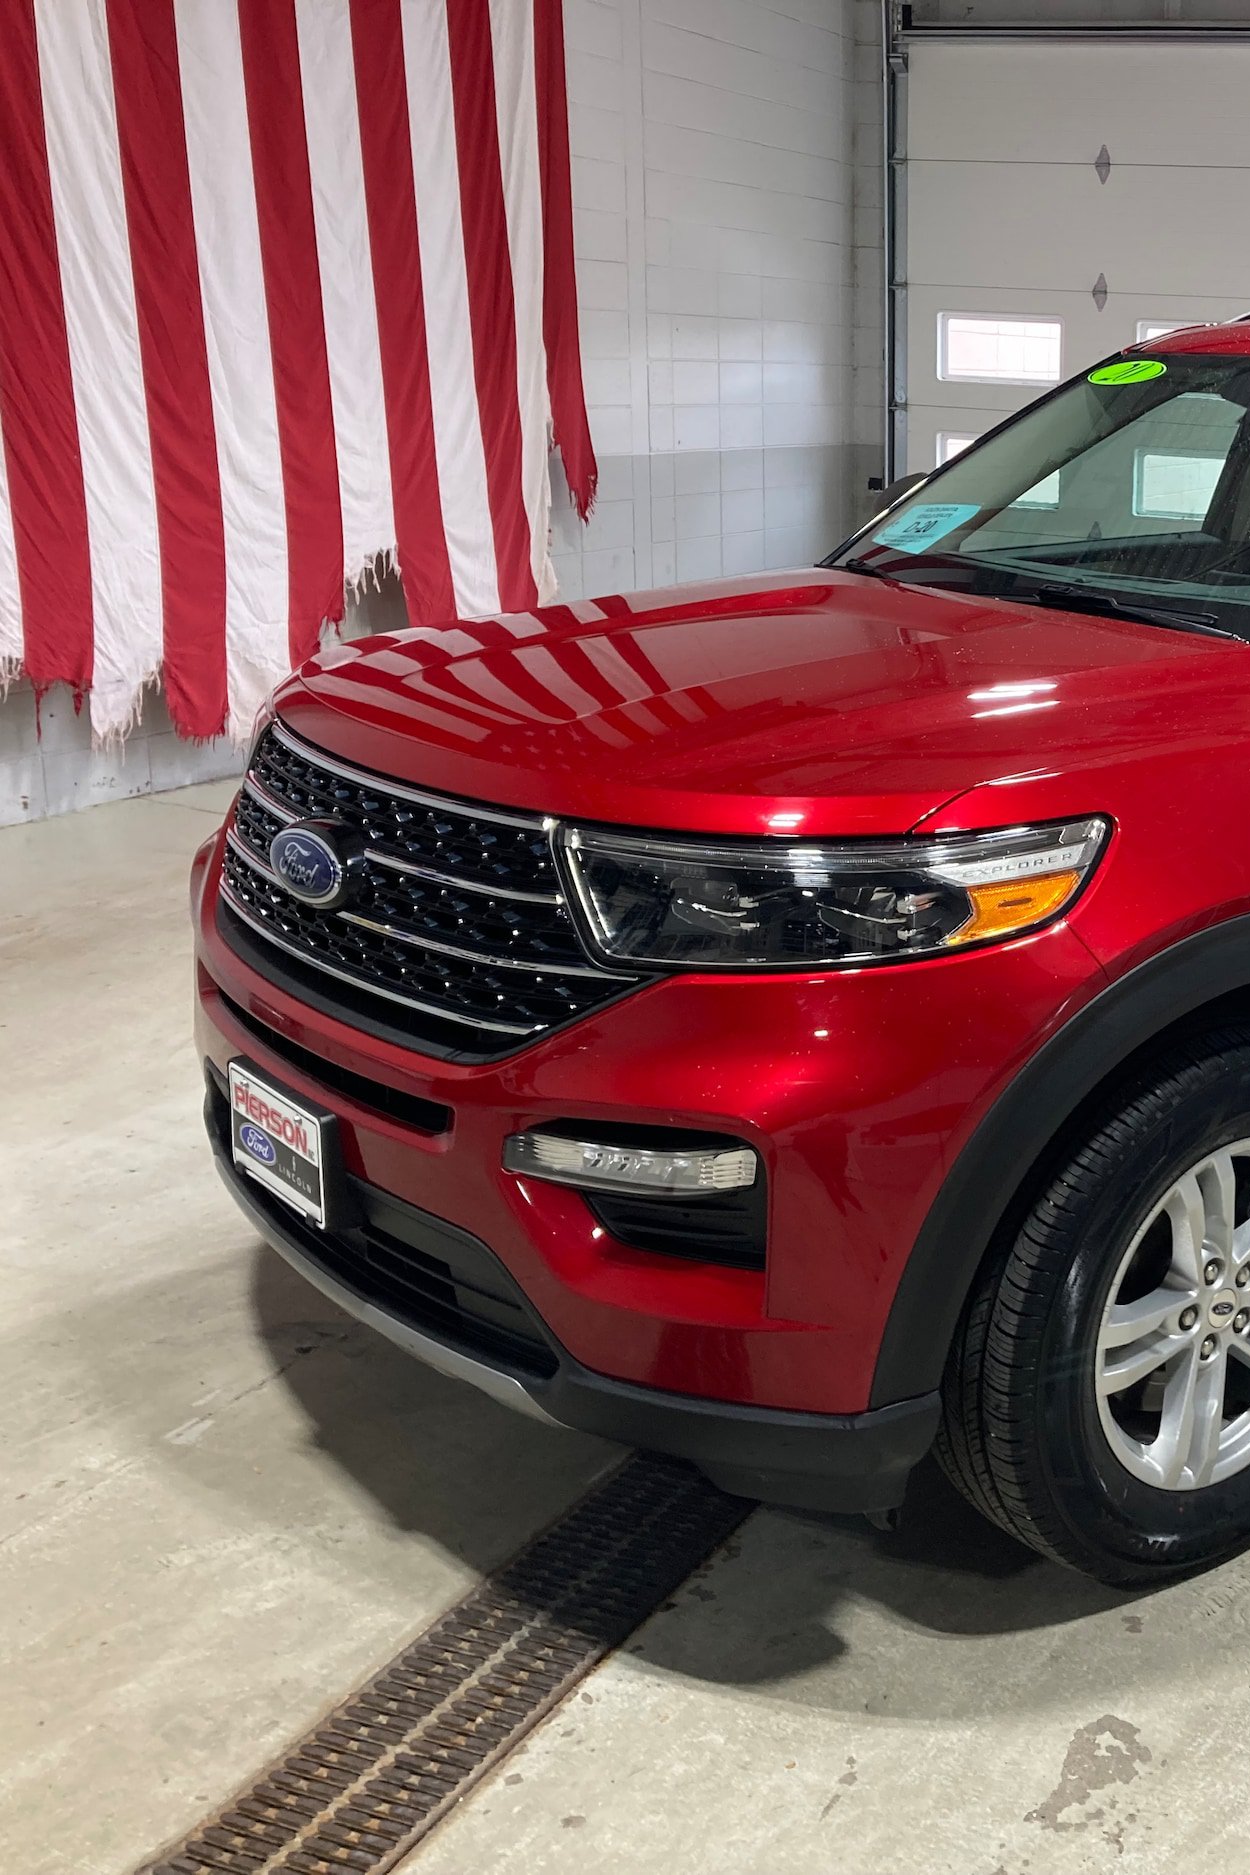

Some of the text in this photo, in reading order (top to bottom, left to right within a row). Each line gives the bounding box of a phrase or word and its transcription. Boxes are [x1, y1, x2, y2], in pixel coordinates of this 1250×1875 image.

[279, 841, 320, 889] Ford
[962, 852, 1072, 878] EXPLORER
[233, 1082, 309, 1158] PIERSON
[247, 1129, 270, 1159] Ford
[278, 1163, 313, 1194] LINCOLN
